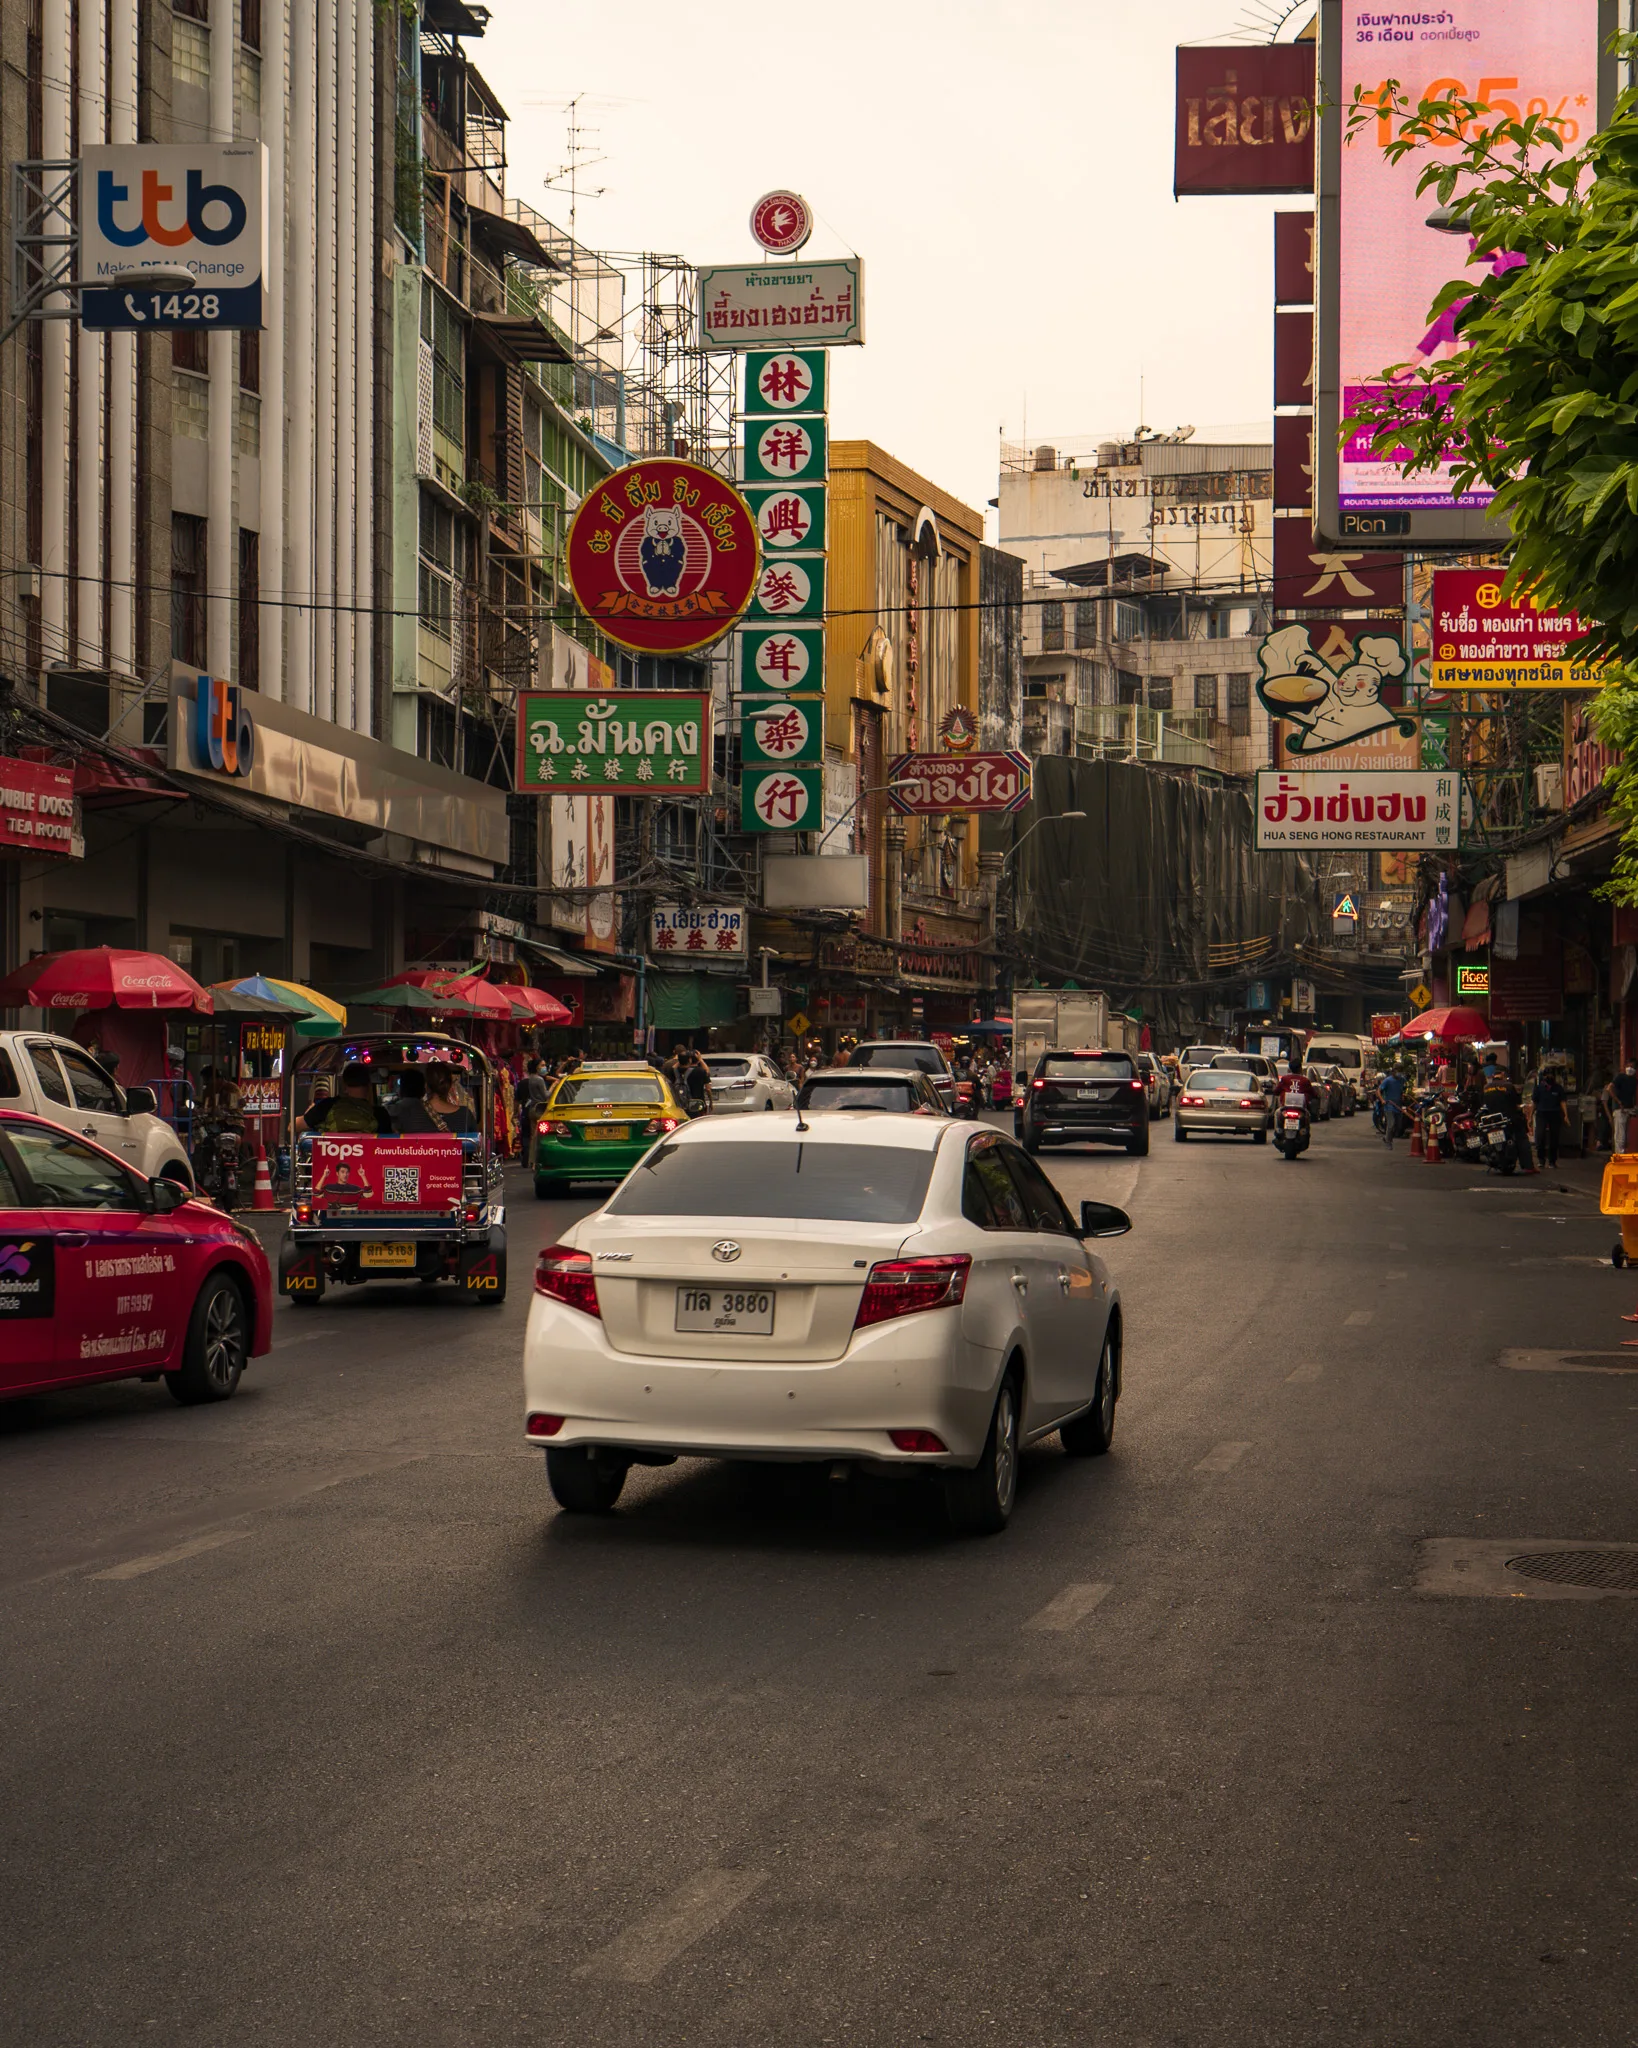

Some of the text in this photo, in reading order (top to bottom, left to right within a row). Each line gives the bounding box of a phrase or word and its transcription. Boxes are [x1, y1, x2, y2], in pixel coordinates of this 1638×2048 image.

[1357, 10, 1453, 26] เงินฝากประจำ
[1356, 26, 1480, 42] 36 เดือน ดอกเบี้ยสูง
[98, 169, 247, 247] ttb
[186, 261, 244, 276] Change
[745, 272, 813, 287] ห้างขายยา
[151, 294, 219, 319] 1428
[1457, 496, 1474, 505] SCB
[1344, 515, 1386, 533] Plan
[1439, 605, 1477, 633] รับซื้อ
[1482, 612, 1533, 633] ทองเก่า
[1538, 617, 1572, 633] เพชร
[1460, 637, 1529, 659] ทองคำขาว
[1438, 663, 1563, 687] เศษทองทุกชนิด
[198, 676, 254, 777] ttb
[529, 699, 698, 755] ฉ.มั่นคง
[908, 760, 964, 775] ห้างทอง
[39, 795, 73, 816] DOGS
[7, 818, 71, 840] TEA ROOM
[1263, 831, 1426, 841] HUA SENG HONG RESTAURANT
[121, 975, 173, 988] Coca-Cola
[51, 992, 89, 1006] Coca-Cola
[317, 1141, 364, 1160] Tops
[374, 1145, 462, 1158] ค้นพบโปรโมชั่นดีๆ ทุกวัน
[387, 1245, 413, 1256] 5163
[596, 1251, 634, 1261] VIOS
[684, 1290, 768, 1314] กล 3880
[713, 1314, 736, 1328] ภูเก็ต
